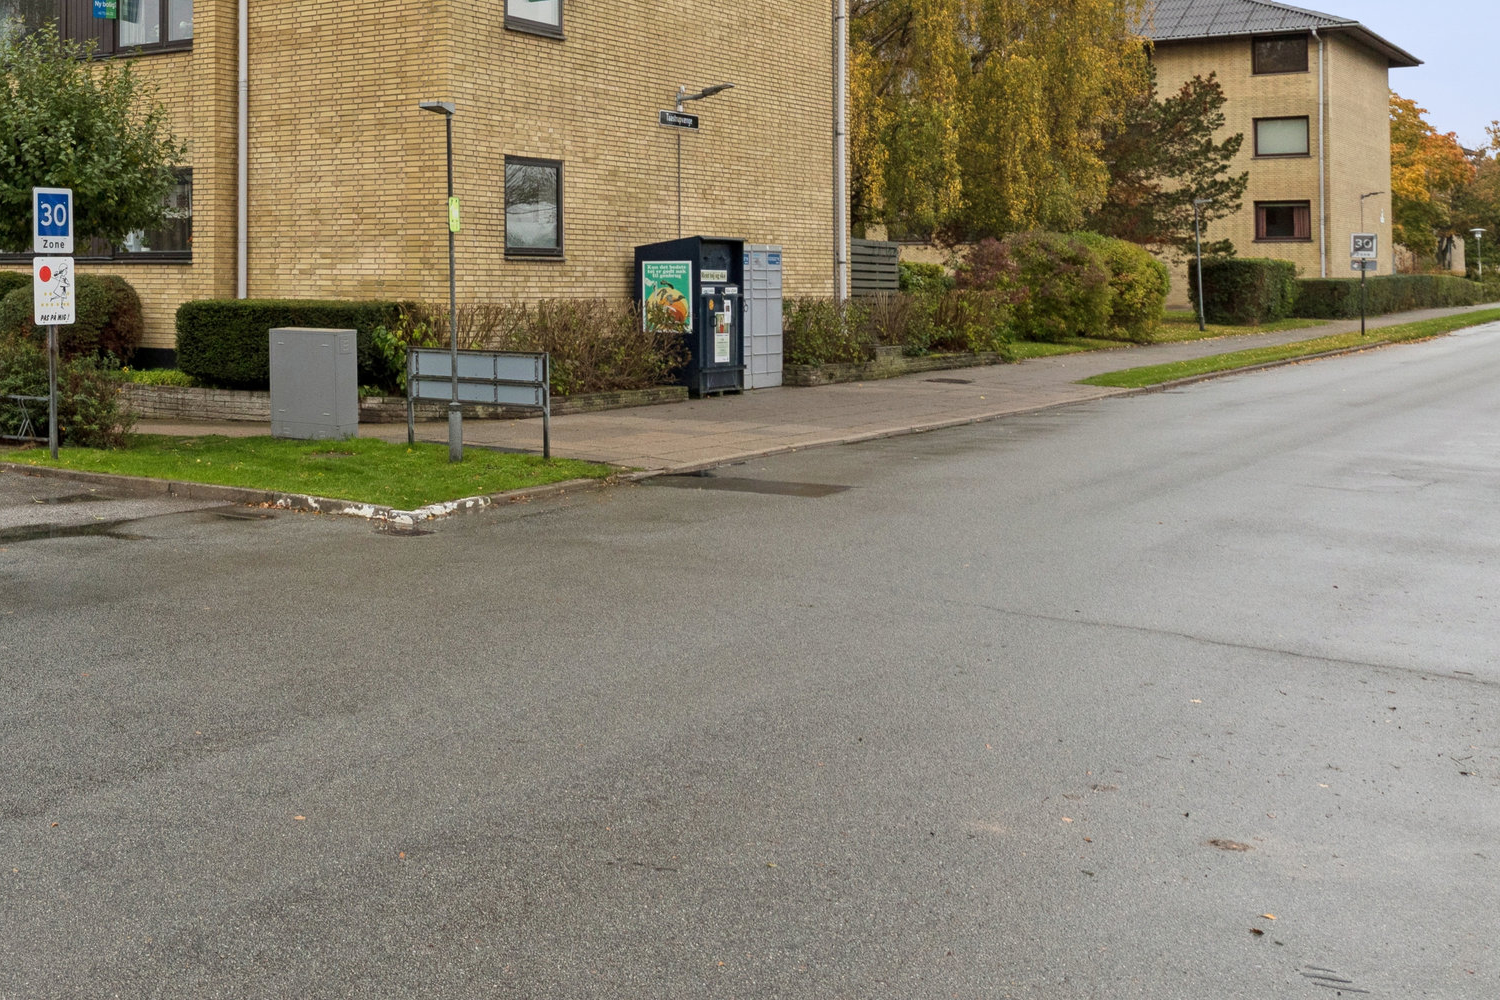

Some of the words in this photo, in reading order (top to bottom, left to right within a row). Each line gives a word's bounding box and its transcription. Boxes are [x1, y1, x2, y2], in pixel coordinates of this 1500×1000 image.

[95, 0, 101, 8] Ny
[40, 203, 66, 226] 30
[43, 240, 65, 248] Zone
[1355, 239, 1372, 249] 30
[50, 312, 57, 321] PÅ
